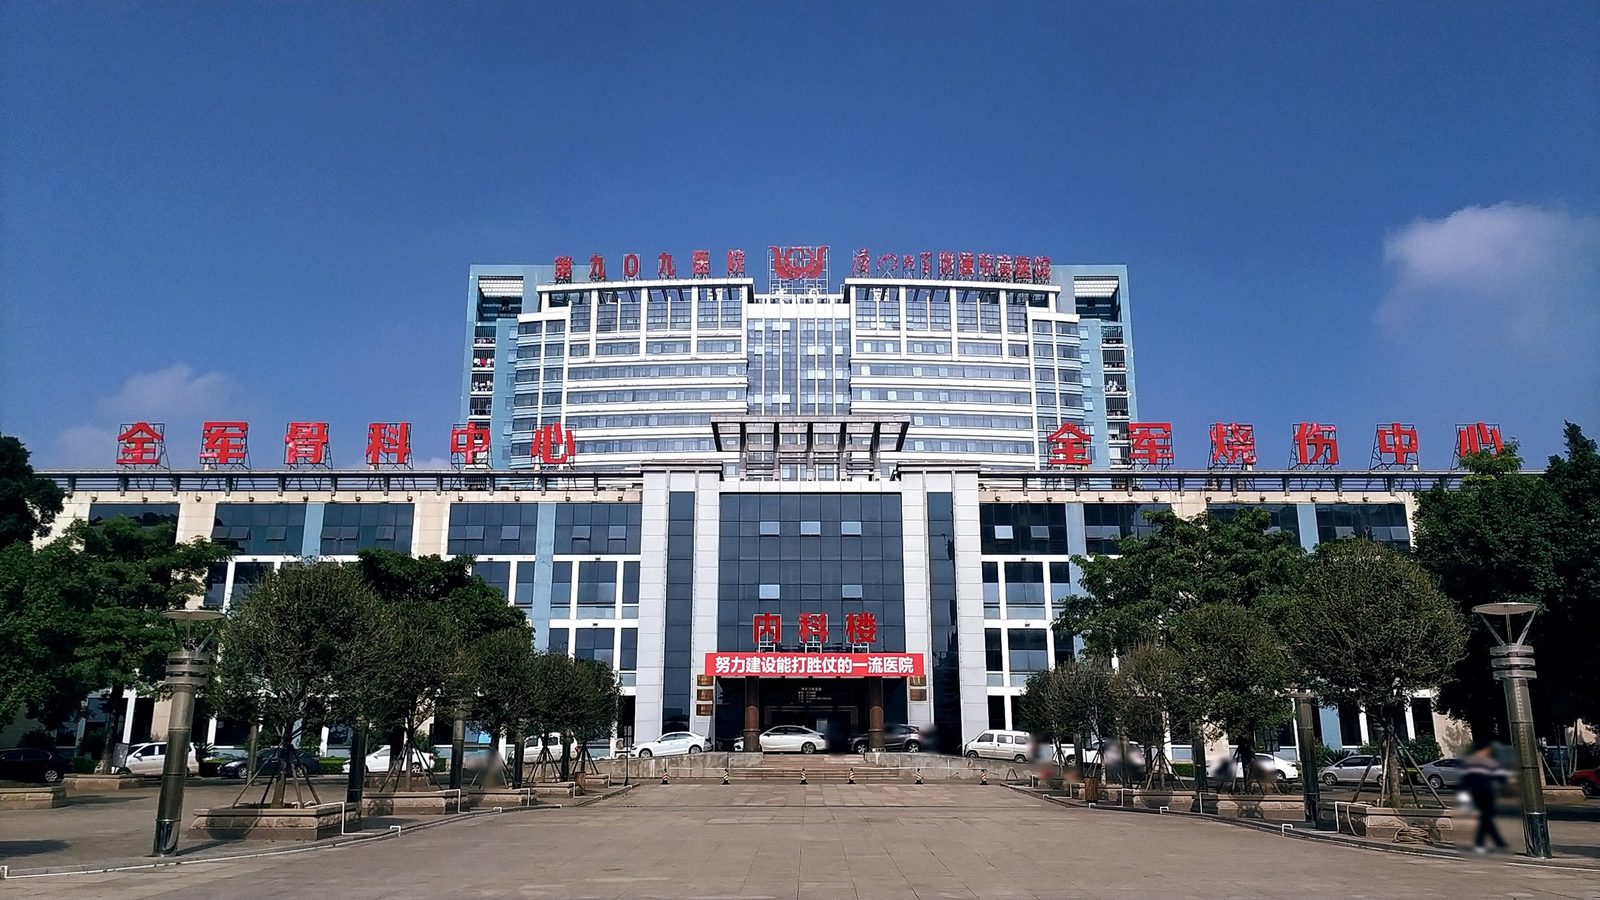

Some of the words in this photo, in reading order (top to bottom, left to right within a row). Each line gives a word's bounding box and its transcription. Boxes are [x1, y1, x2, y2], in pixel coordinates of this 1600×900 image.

[116, 421, 576, 464] 全军骨科中心
[1047, 422, 1505, 464] 全军烧伤中心
[753, 612, 878, 643] 内科楼
[715, 656, 914, 674] 努力建设能打胜仗的一流医院
